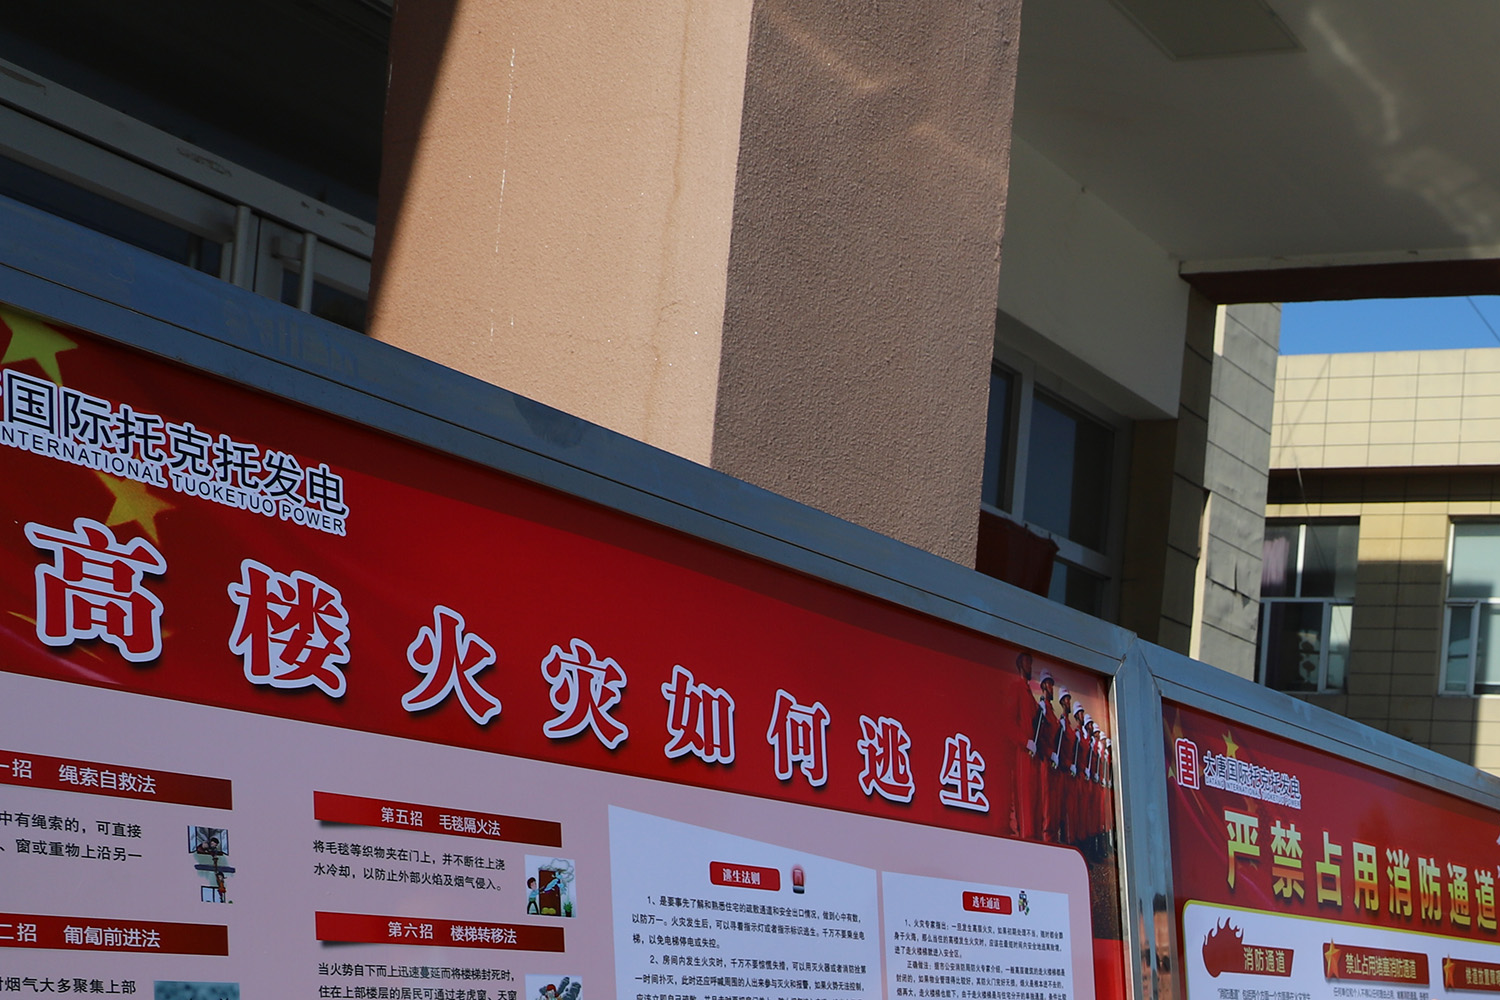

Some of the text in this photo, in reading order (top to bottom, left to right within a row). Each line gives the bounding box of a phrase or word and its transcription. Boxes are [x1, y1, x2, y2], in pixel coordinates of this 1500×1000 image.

[0, 368, 348, 516] 国际托克托发电
[0, 425, 347, 535] NTERNATIONAL TUOKETUO POWER
[24, 517, 990, 813] 高楼火灾如何逃生
[58, 764, 156, 794] 绳索自救法
[1203, 750, 1301, 799] 大唐国际托克托发电
[0, 811, 142, 839] 中有绳索的，可直接
[381, 806, 501, 836] 第五招 毛毯隔火法
[313, 840, 505, 871] 将毛毯等织物夹在门上，并不断往上浇
[1224, 809, 1498, 931] 严禁占用消防通道
[313, 862, 503, 891] 水冷却，以防止外部火焰及烟气侵入。
[722, 868, 761, 885] 逃生法则
[63, 925, 161, 948] 匍匐前进法
[388, 922, 517, 945] 第六招 楼梯转移法
[1243, 947, 1286, 973] 消防通道
[0, 977, 136, 995] 烟气大多聚集上部
